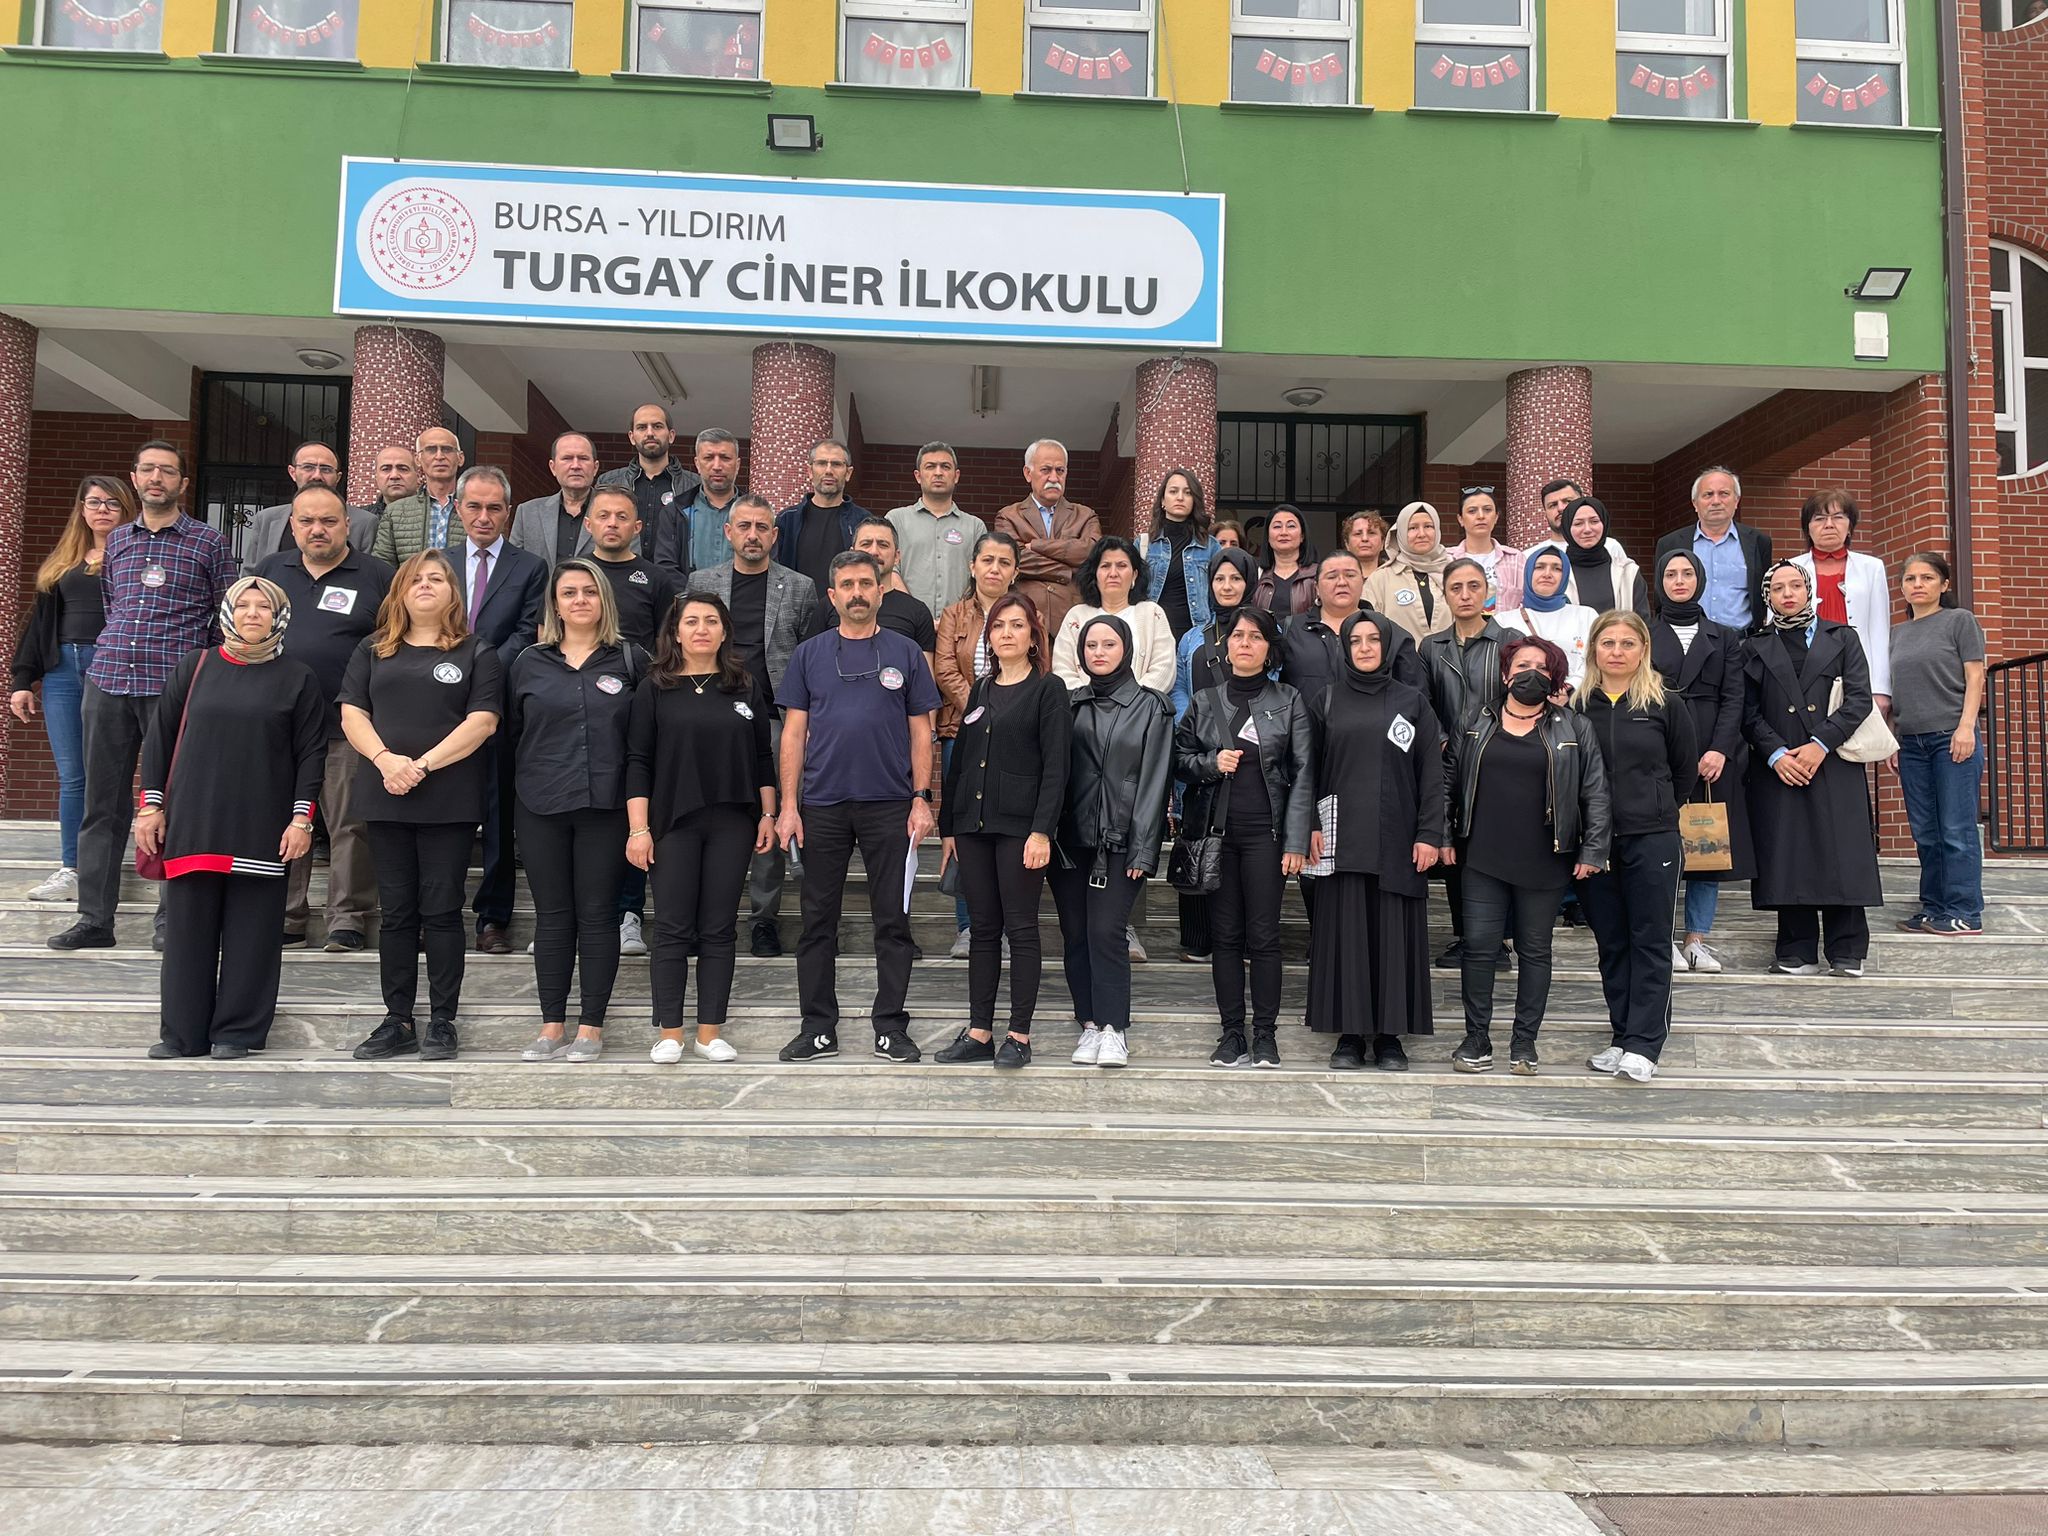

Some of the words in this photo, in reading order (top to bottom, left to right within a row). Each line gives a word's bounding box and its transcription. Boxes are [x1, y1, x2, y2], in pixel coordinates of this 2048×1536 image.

[494, 201, 608, 235] BURSA
[637, 208, 785, 242] YILDIRIM
[493, 249, 714, 298] TURGAY
[726, 252, 884, 306] CİNER
[899, 258, 1158, 316] İLKOKULU
